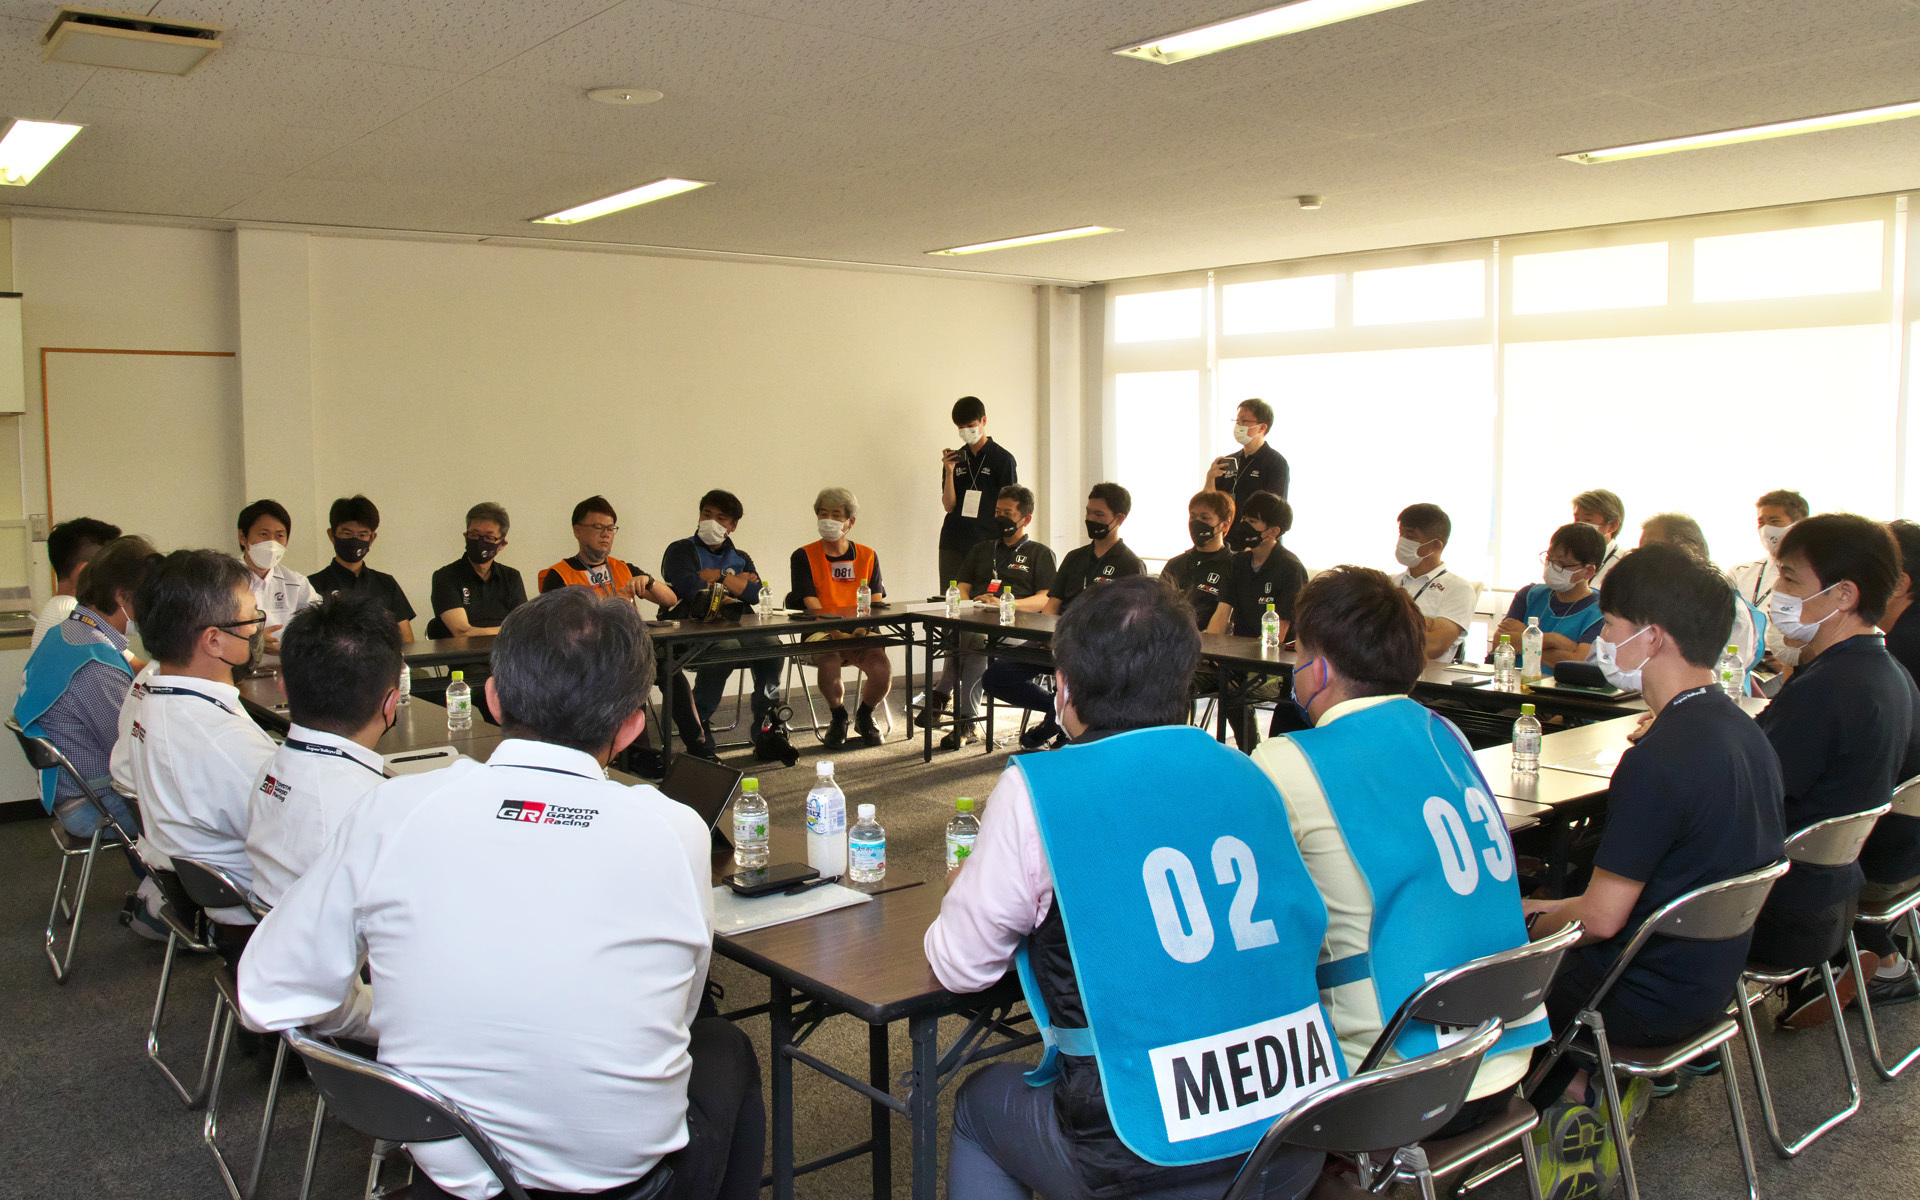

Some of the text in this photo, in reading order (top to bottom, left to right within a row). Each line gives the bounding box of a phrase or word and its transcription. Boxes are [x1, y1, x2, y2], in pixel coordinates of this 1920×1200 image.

[590, 570, 609, 584] 024
[834, 567, 852, 578] 081
[497, 805, 544, 823] GR
[546, 811, 593, 821] GAZOO
[548, 804, 600, 815] TOYOTA
[544, 818, 590, 828] Racing
[1423, 787, 1513, 896] 03
[1142, 835, 1280, 964] 02
[1172, 1021, 1331, 1120] MEDIA
